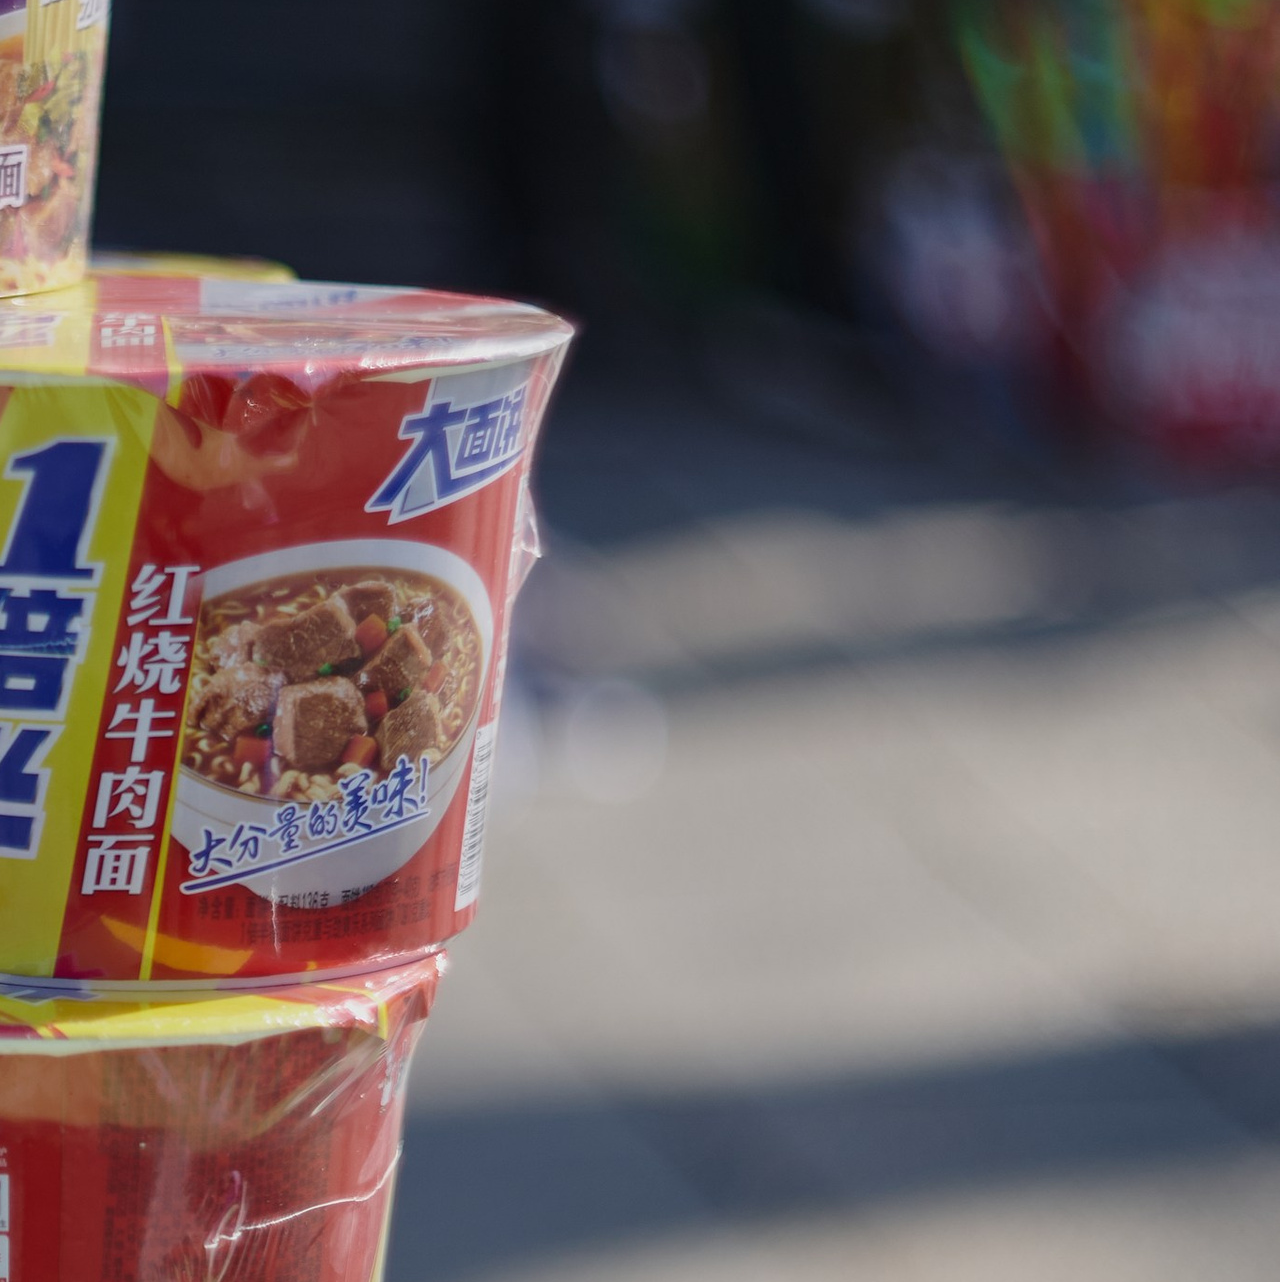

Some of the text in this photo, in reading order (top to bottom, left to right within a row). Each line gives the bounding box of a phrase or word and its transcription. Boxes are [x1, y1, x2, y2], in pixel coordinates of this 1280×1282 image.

[82, 564, 203, 896] 红烧牛肉面
[187, 757, 431, 876] 大分量的美味!
